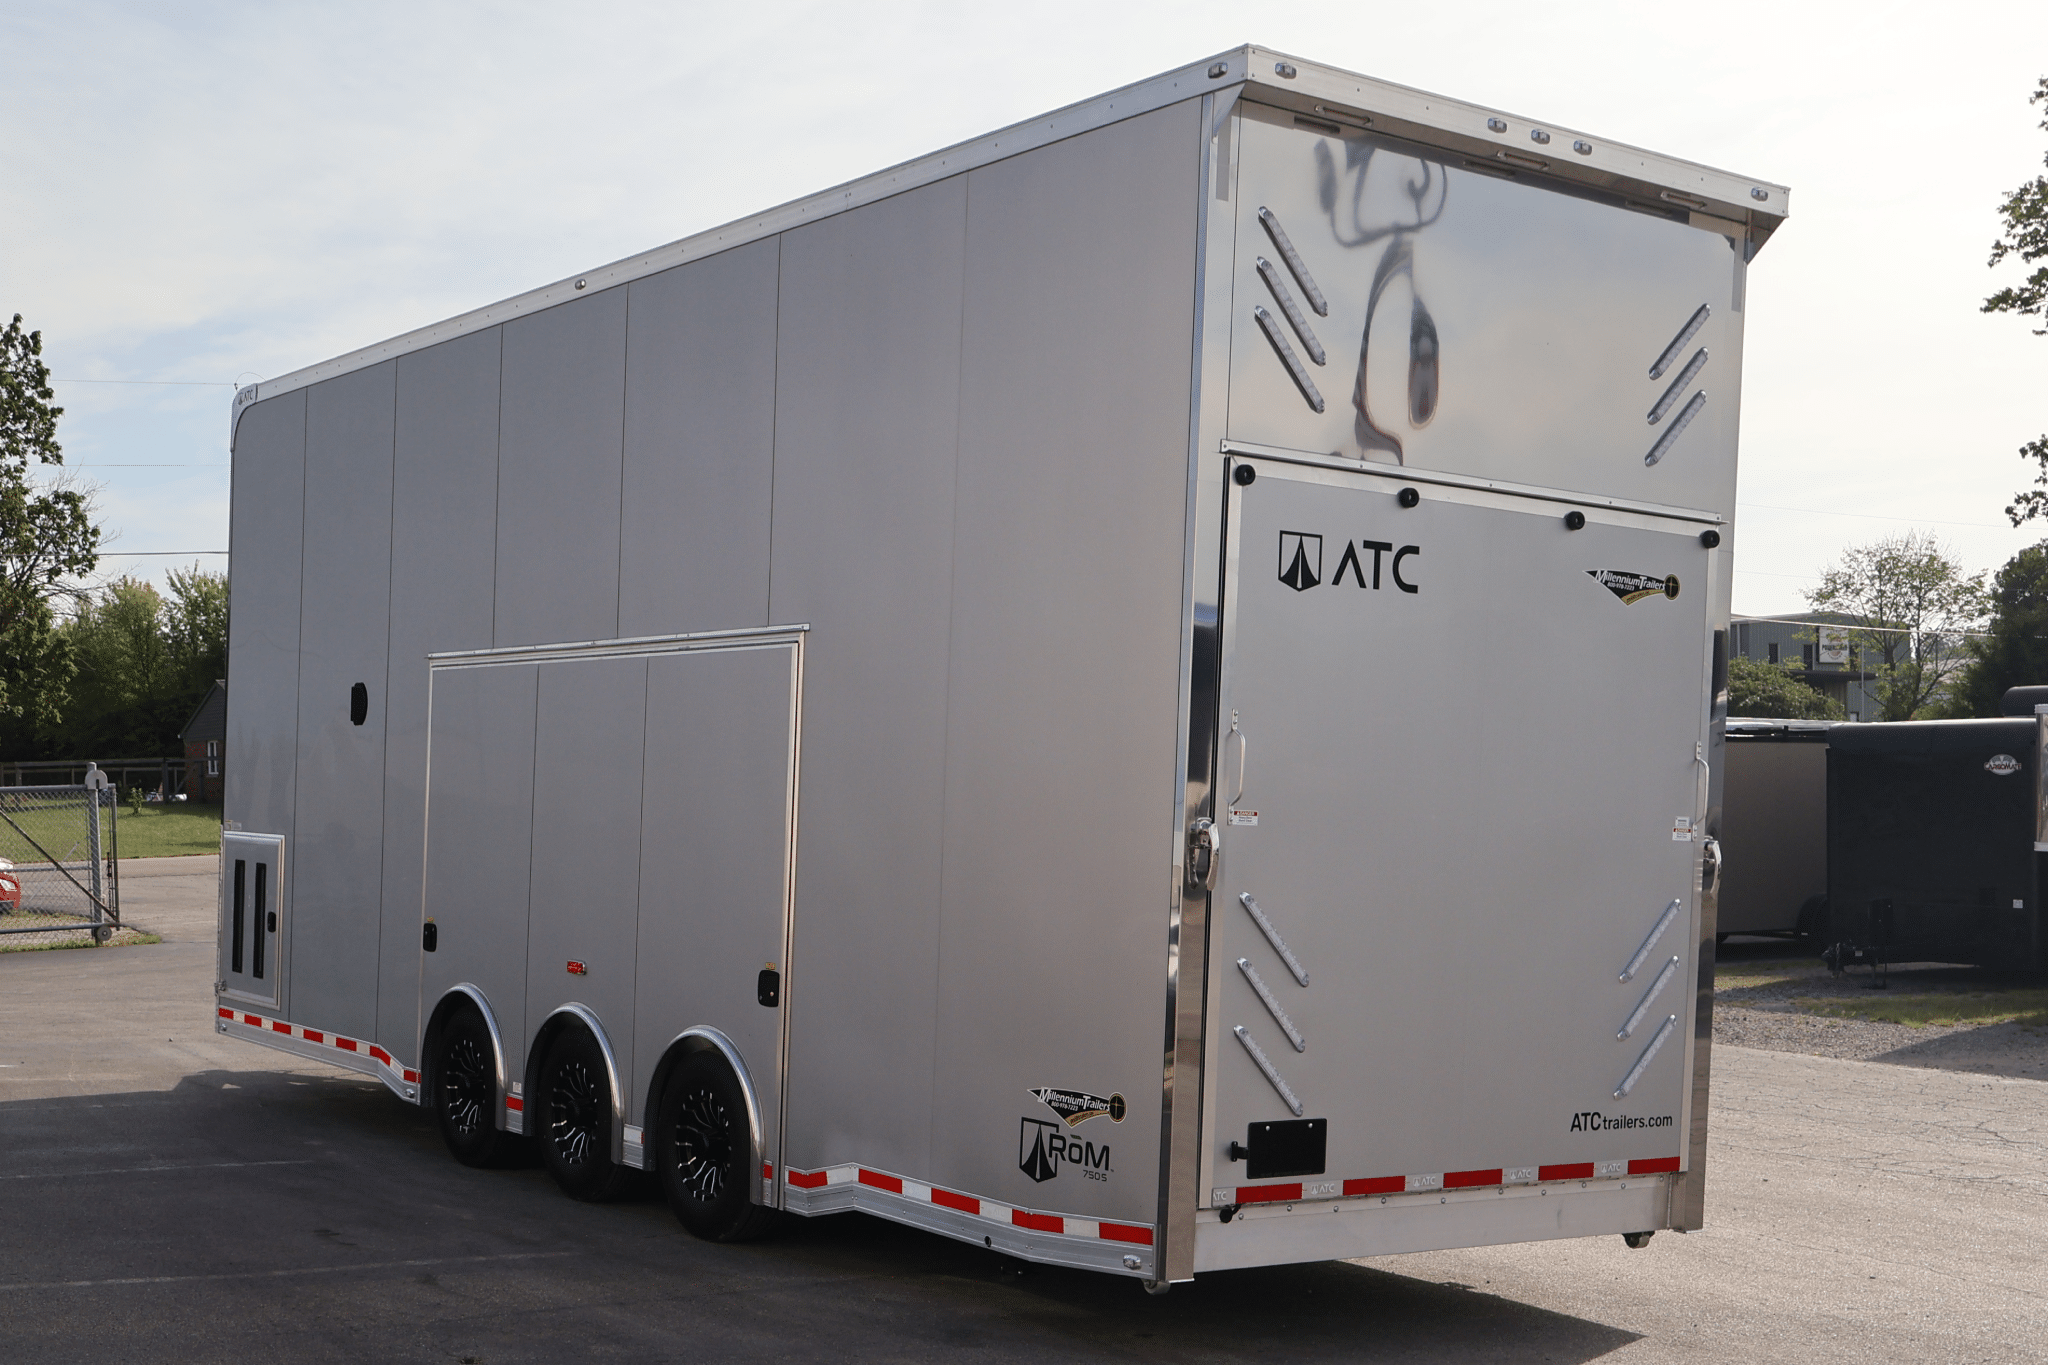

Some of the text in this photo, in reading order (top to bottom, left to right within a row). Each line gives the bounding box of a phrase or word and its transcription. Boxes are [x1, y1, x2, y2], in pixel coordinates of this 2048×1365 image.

[1331, 539, 1420, 594] ATC
[1570, 1112, 1673, 1132] ATCtrailers.com
[1607, 1163, 1621, 1172] ATC
[1516, 1169, 1531, 1179] ATC
[1421, 1176, 1436, 1186] ATC
[1319, 1183, 1335, 1193] ATC
